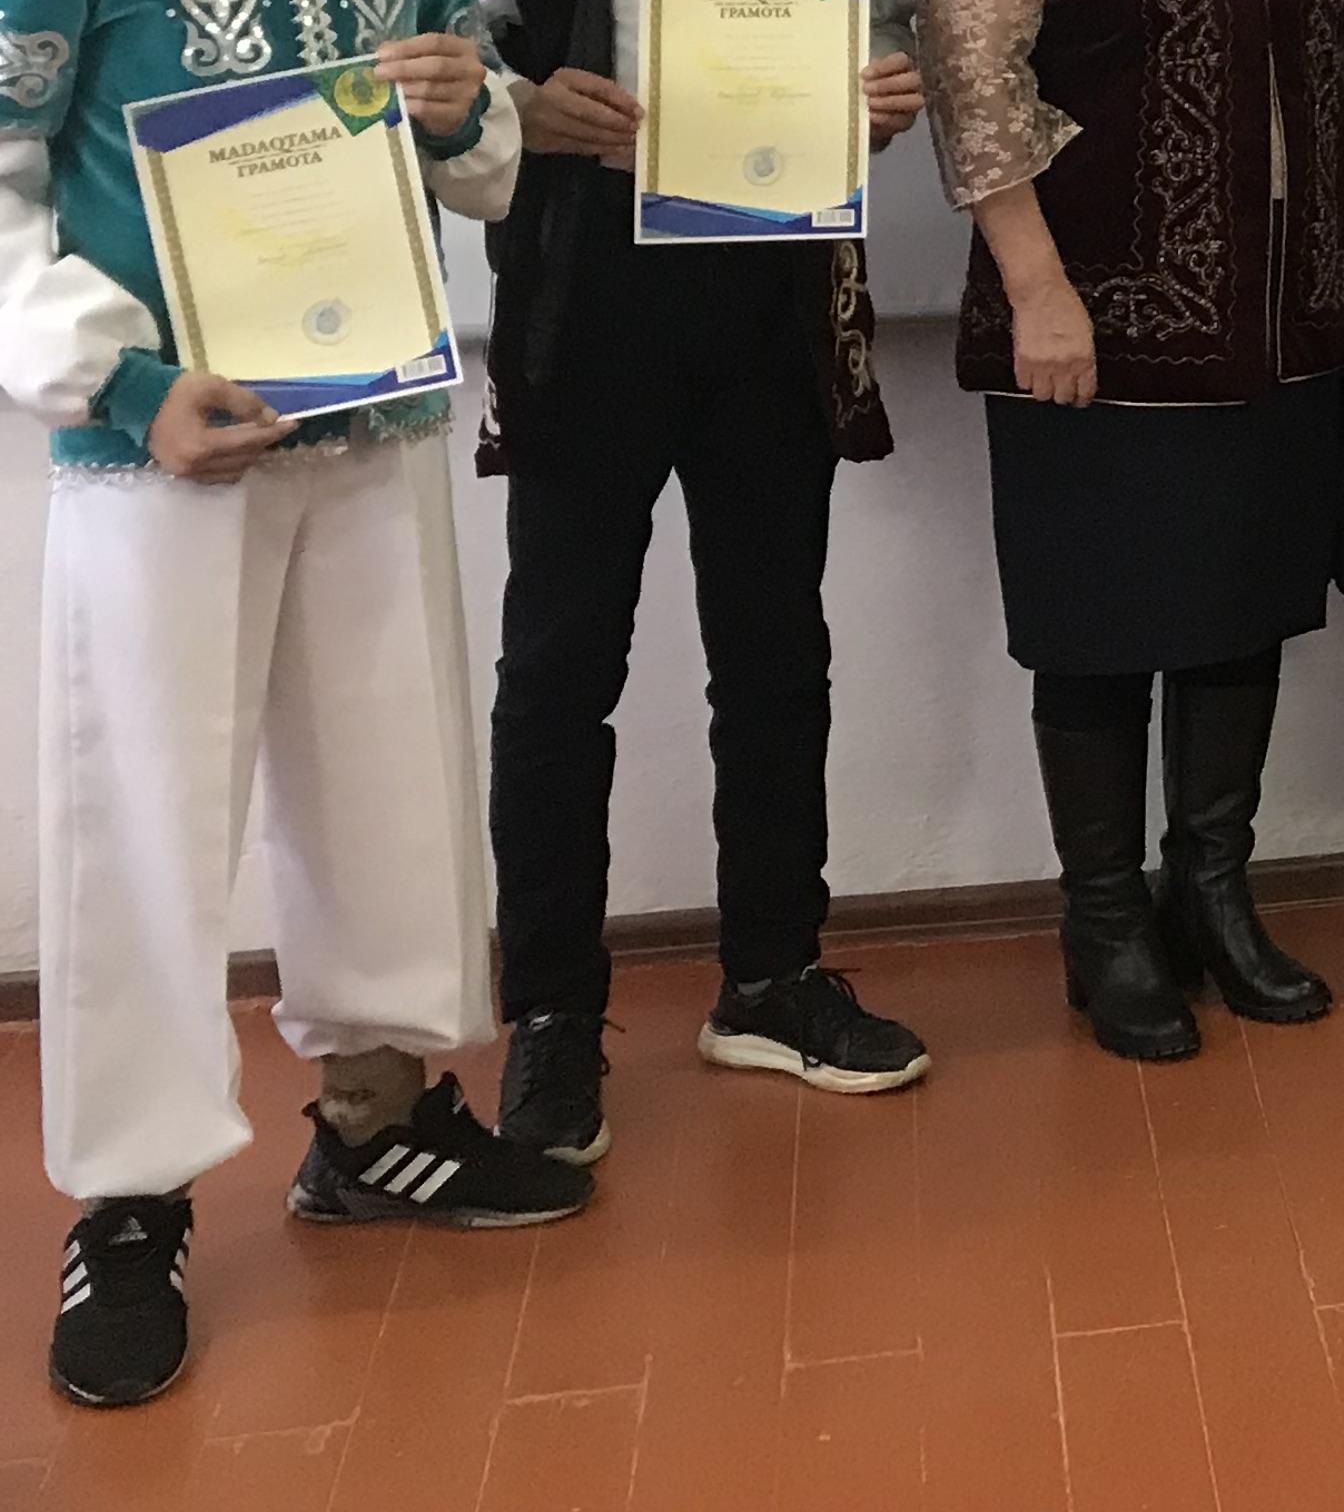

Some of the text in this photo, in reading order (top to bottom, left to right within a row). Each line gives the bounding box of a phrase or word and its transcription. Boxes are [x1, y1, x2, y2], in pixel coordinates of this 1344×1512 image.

[719, 6, 792, 19] ГРАМОТА
[208, 125, 344, 165] MADAQTAMA
[236, 150, 323, 179] ГРАМОТА
